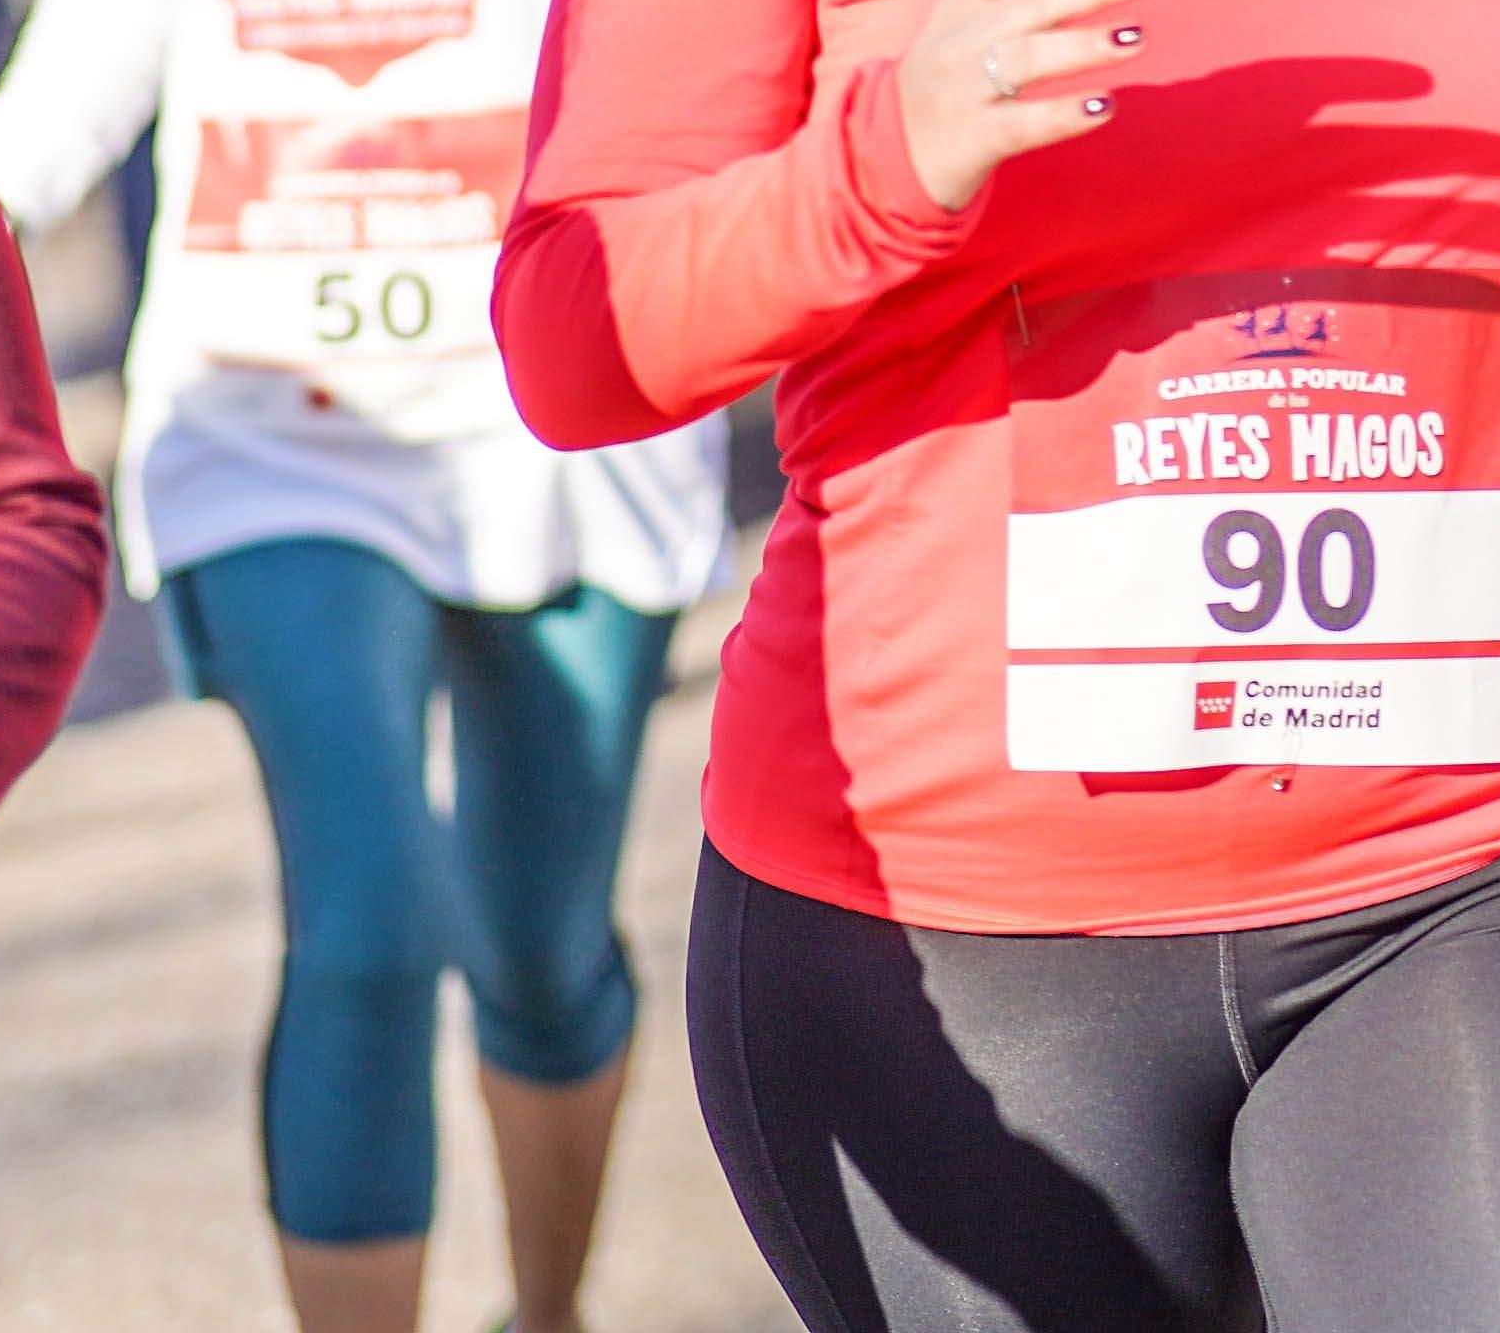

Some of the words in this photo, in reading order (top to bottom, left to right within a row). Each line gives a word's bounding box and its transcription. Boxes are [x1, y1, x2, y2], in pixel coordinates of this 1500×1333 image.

[314, 271, 433, 344] 50
[1158, 367, 1284, 401] CARRERA
[1289, 367, 1406, 397] POPULAR
[1111, 412, 1270, 486] REYES
[1290, 411, 1445, 483] MAGOS
[1202, 507, 1376, 633] 90
[1244, 680, 1383, 699] Comunidad
[1242, 708, 1273, 727] de
[1285, 707, 1381, 729] Madrid
